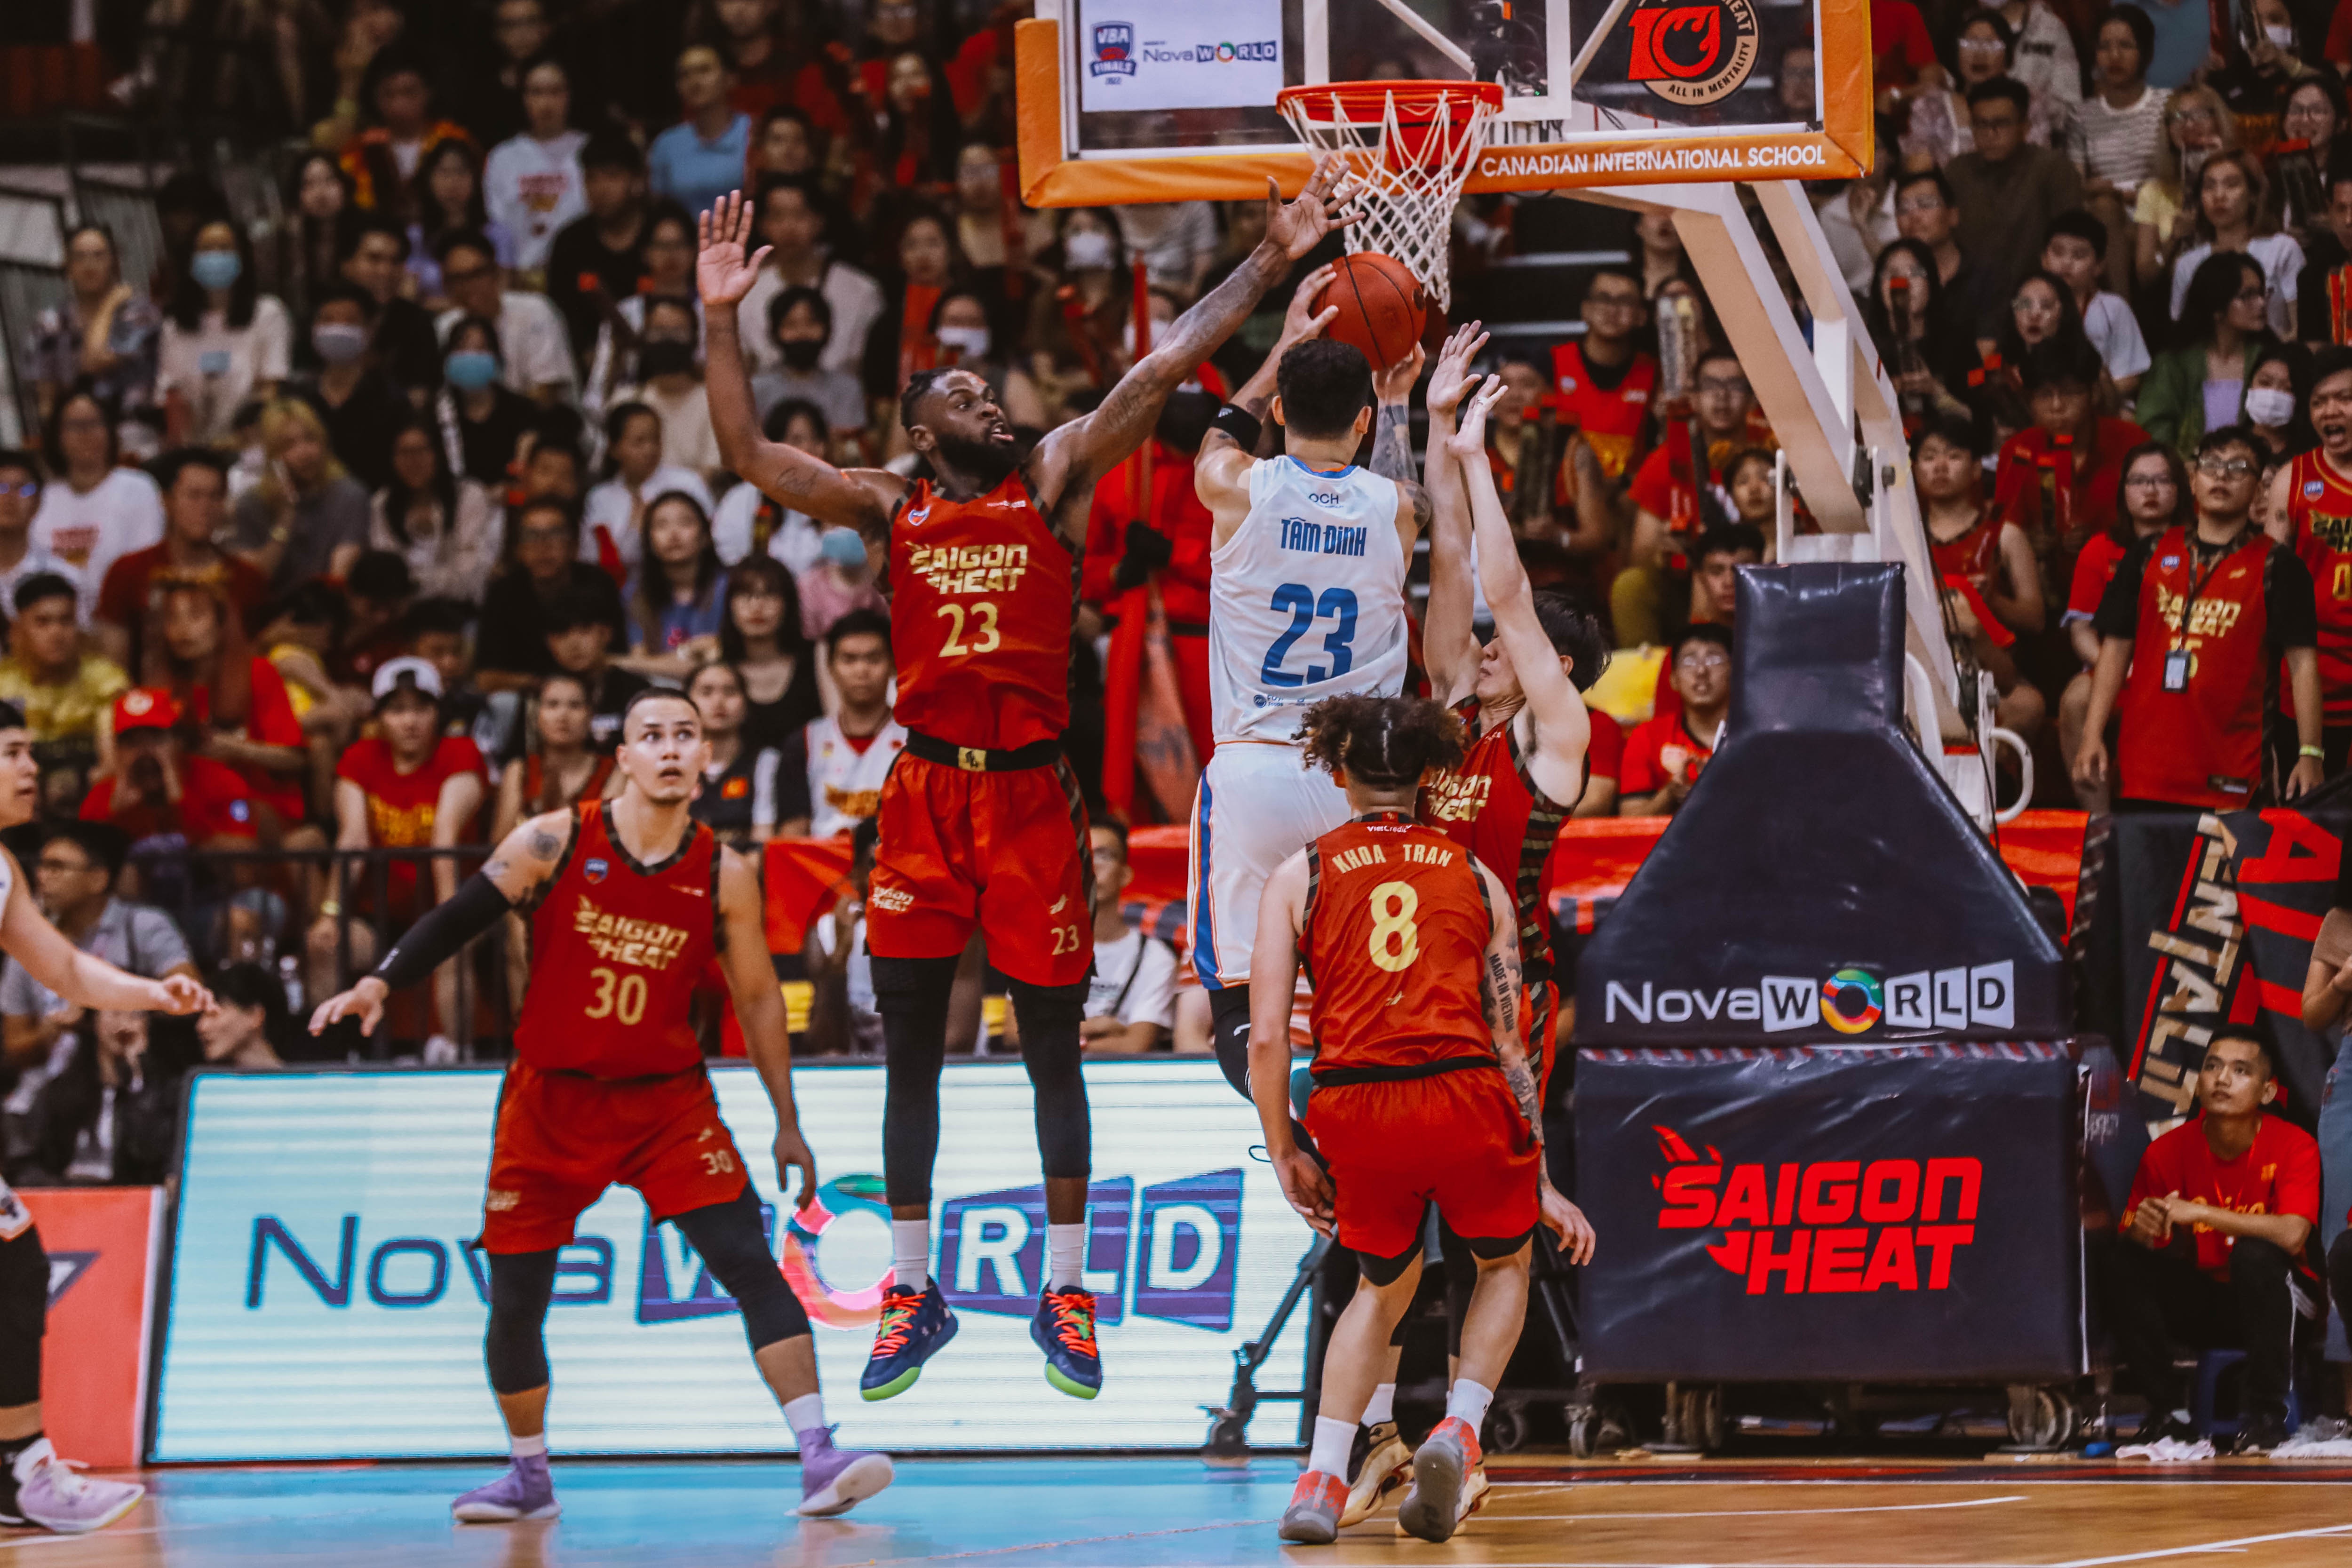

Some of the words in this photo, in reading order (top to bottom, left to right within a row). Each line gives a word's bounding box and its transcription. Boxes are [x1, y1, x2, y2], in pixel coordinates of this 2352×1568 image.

[1669, 84, 1687, 96] ALL
[1693, 88, 1704, 97] IN
[1708, 42, 1750, 94] MENTALITY
[1481, 154, 1588, 177] CANADIAN
[1594, 148, 1742, 172] INTERNATIONAL
[1748, 144, 1826, 167] SCHOOL
[1309, 493, 1339, 504] OCH
[1281, 517, 1321, 552] TÂM
[911, 545, 1028, 574] SAIGON
[939, 567, 1025, 594] HEAT
[938, 602, 1001, 657] 23
[1261, 583, 1358, 687] 23
[1332, 844, 1387, 874] KHOA
[1403, 844, 1453, 867] TRAN
[573, 910, 690, 950] SAIGON
[1051, 924, 1080, 956] 23
[1369, 881, 1420, 972] 8
[598, 938, 680, 971] HEAT
[1489, 953, 1507, 983] MADE
[584, 966, 648, 1026] 30
[1497, 982, 1510, 995] IN
[1605, 960, 2014, 1034] NovaWORLD
[700, 1149, 734, 1175] 30
[1653, 1155, 1983, 1229] SAIGON
[1746, 1225, 1975, 1295] HEAT
